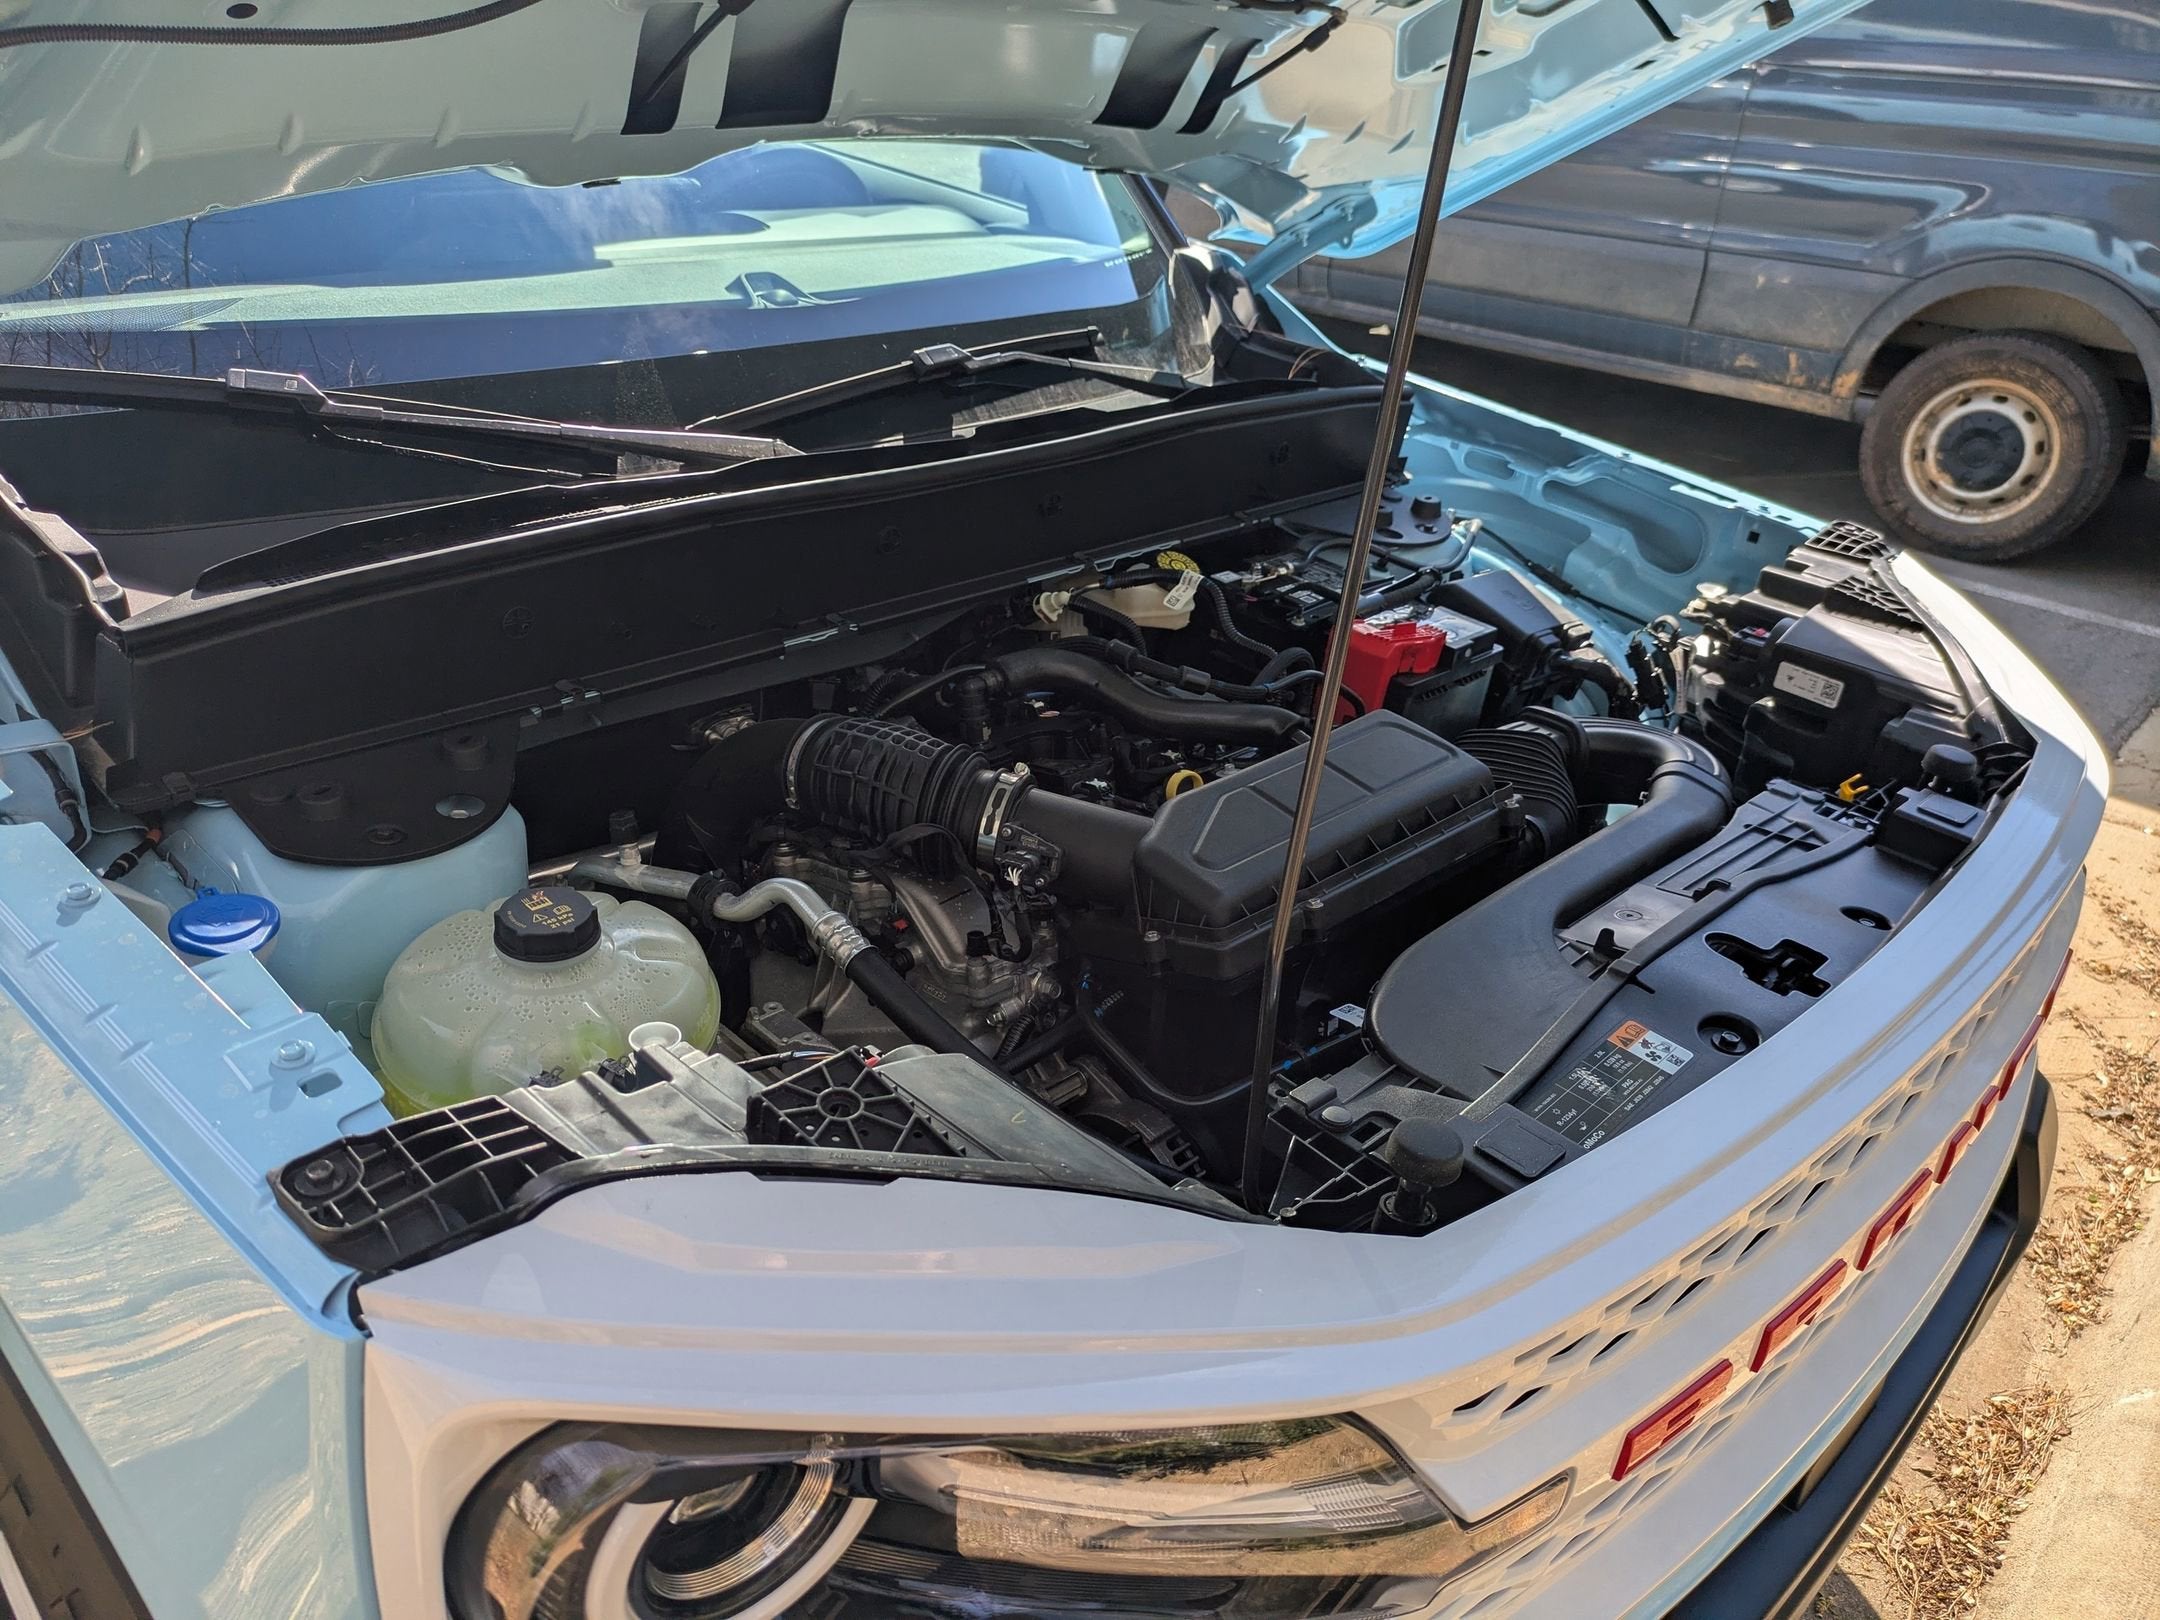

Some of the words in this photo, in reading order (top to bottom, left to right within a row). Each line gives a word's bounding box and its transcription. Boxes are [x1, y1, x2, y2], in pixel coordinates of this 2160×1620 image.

[1621, 1078, 1633, 1088] PAG
[1583, 1130, 1605, 1149] oMoCo
[1610, 948, 2073, 1482] BRON
